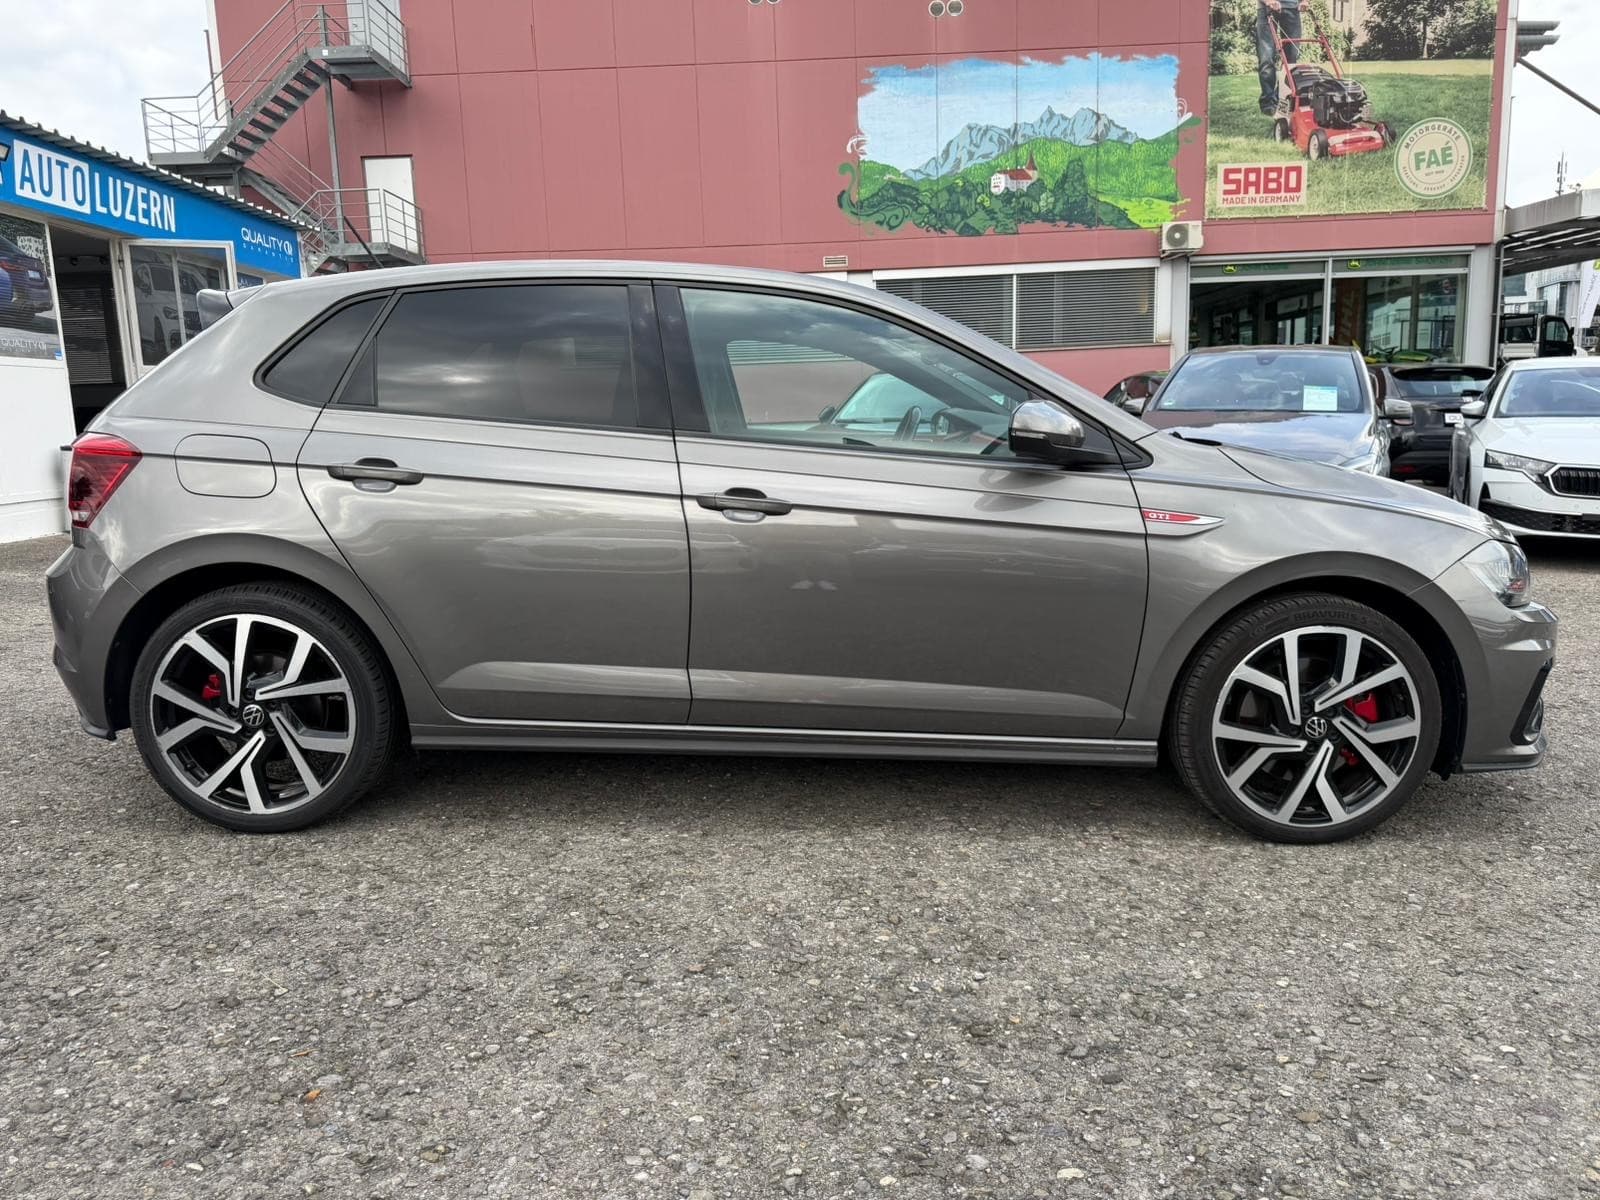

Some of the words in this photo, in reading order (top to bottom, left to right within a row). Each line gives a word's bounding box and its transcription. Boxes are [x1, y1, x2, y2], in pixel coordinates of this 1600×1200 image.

[1414, 140, 1453, 171] FAÉ
[20, 149, 86, 207] AUTO
[95, 172, 176, 233] LUZERN
[1223, 166, 1302, 195] SABO
[1222, 196, 1247, 205] MADE
[1247, 196, 1257, 204] IN
[1259, 195, 1301, 204] GERMANY
[241, 227, 282, 251] QUALITY
[1148, 512, 1170, 520] GTI
